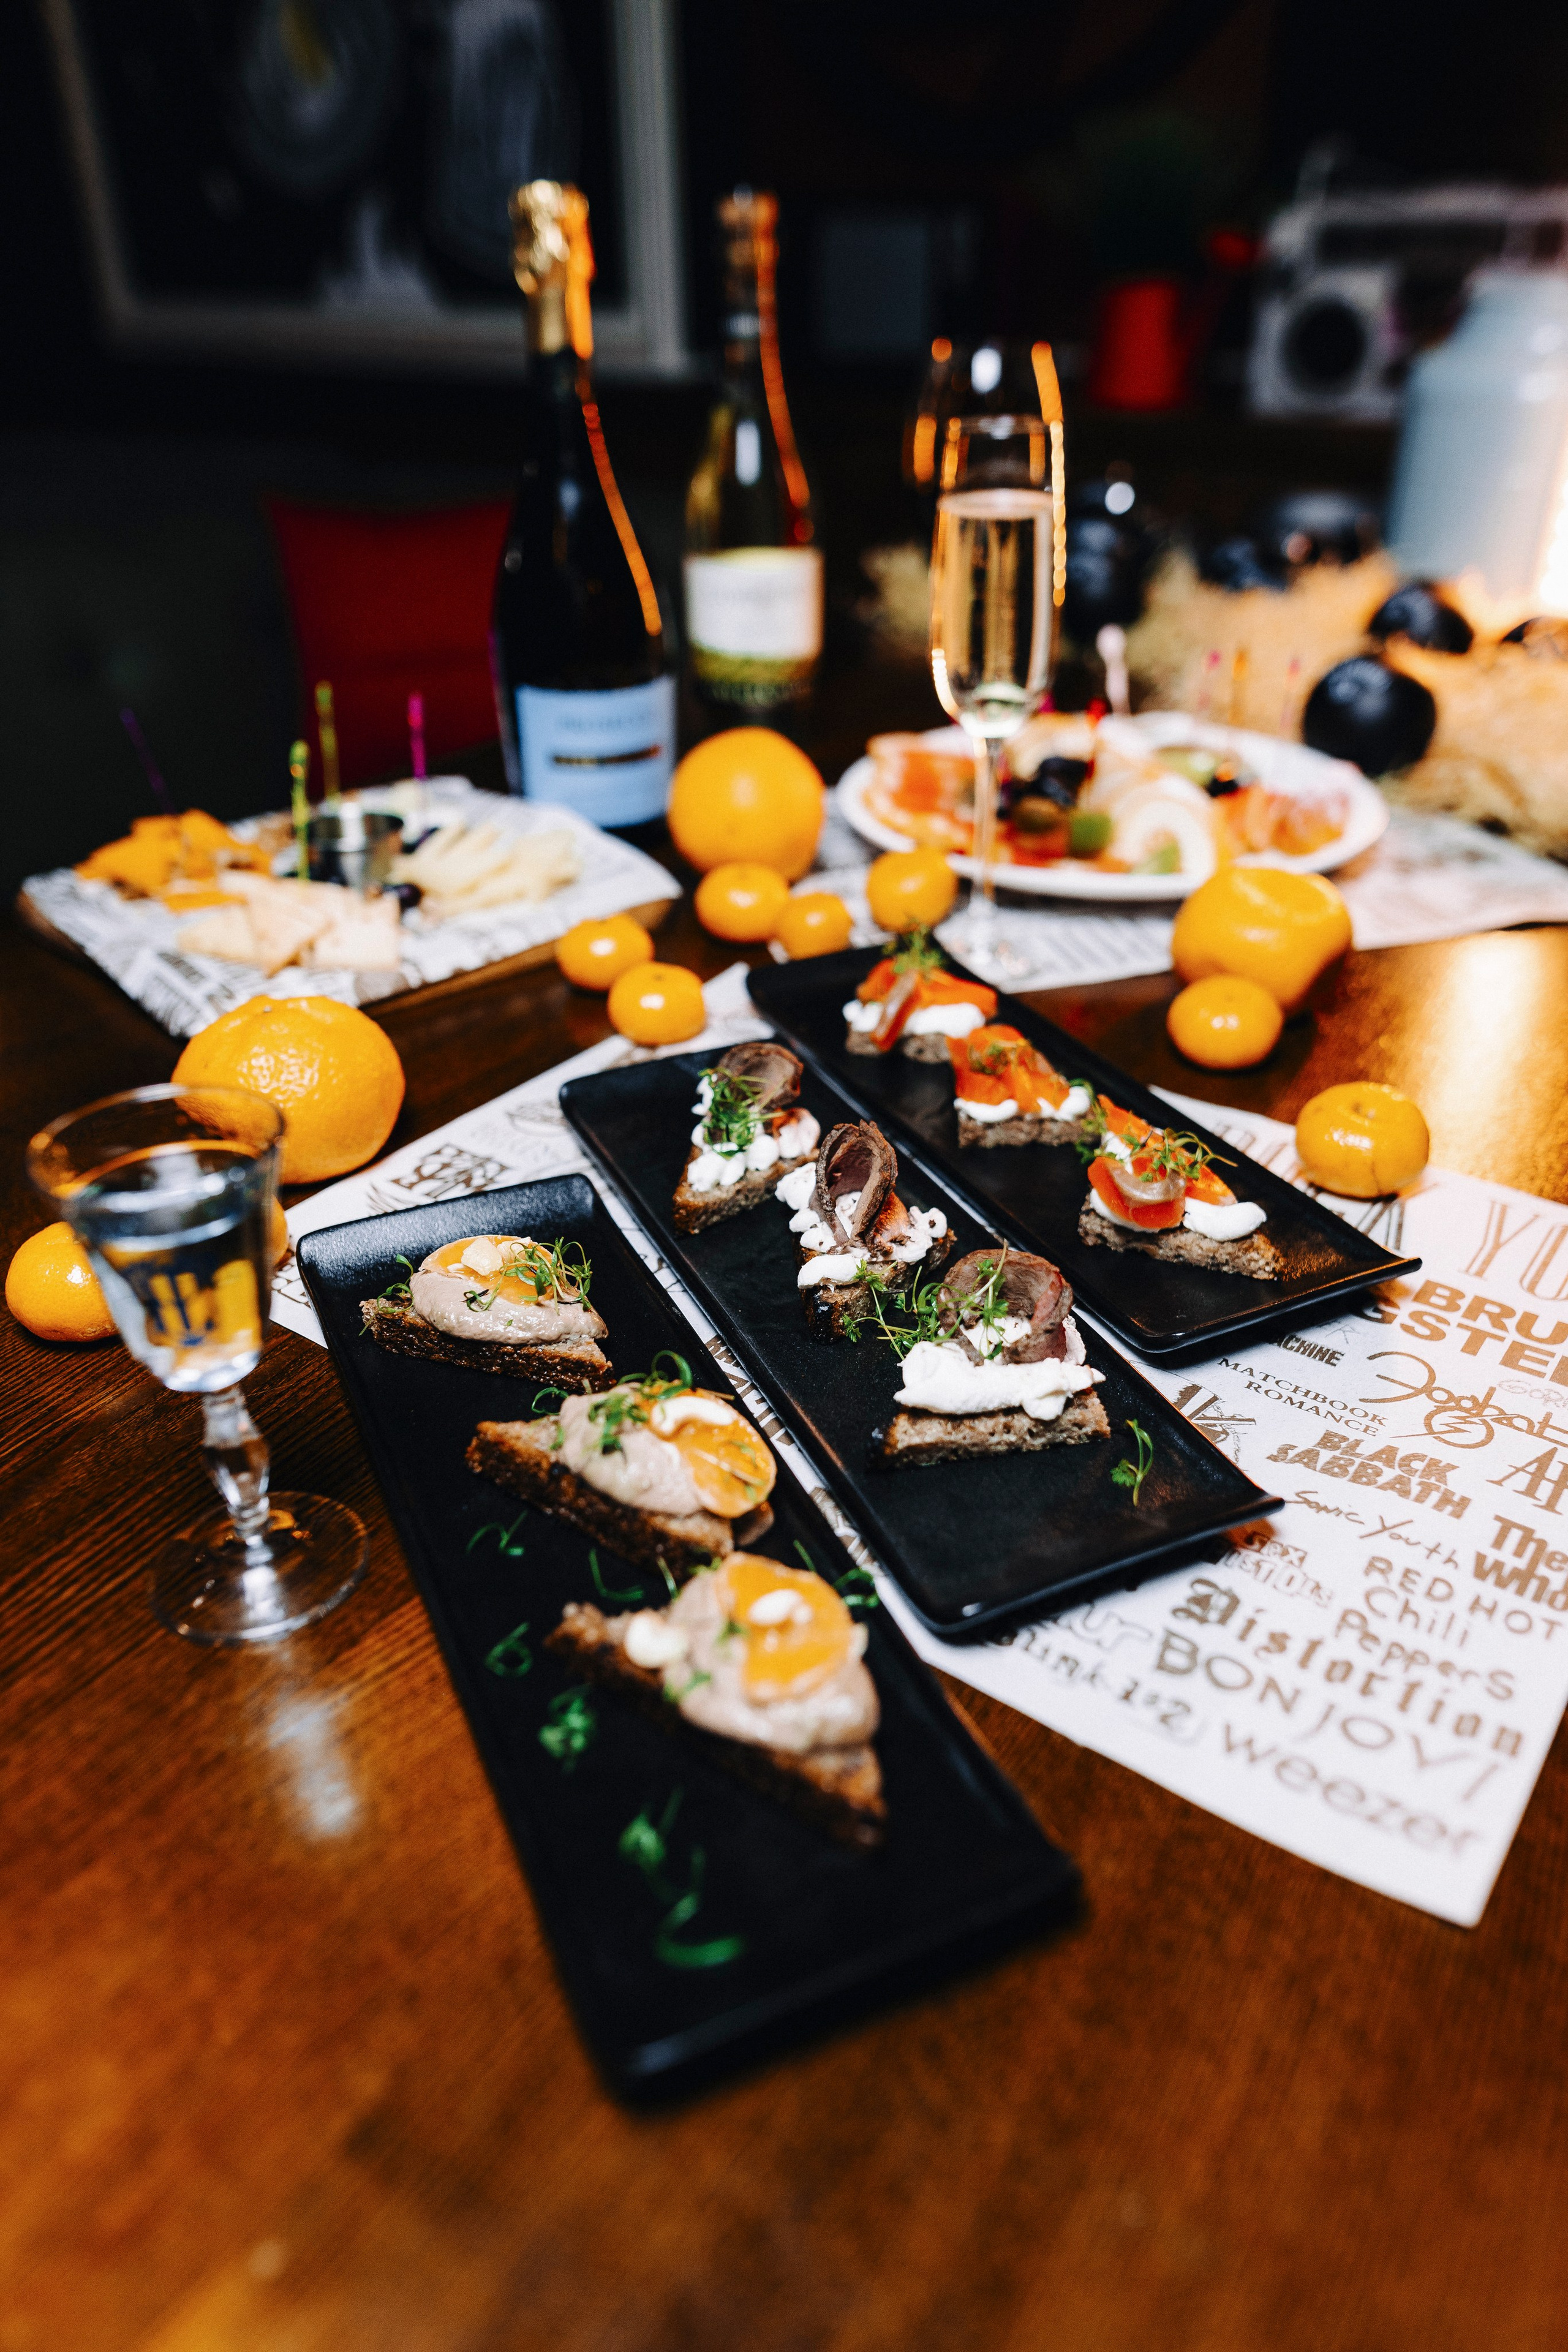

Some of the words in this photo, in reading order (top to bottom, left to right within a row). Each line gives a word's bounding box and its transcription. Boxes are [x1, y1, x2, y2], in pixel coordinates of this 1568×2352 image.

[1278, 1333, 1346, 1366] CHINE
[1217, 1357, 1389, 1427] MATCHBOOK
[1243, 1381, 1379, 1437] ROMANCE
[1266, 1443, 1472, 1520] SABBATH
[1314, 1430, 1460, 1486] BLACK
[1359, 1515, 1458, 1569] Youth
[1364, 1556, 1455, 1602] RED
[1468, 1594, 1566, 1642] HOT
[1364, 1586, 1470, 1648] Chili
[1155, 1626, 1301, 1713] BON
[1294, 1703, 1501, 1802] JOVI
[1224, 1722, 1479, 1857] weezer
